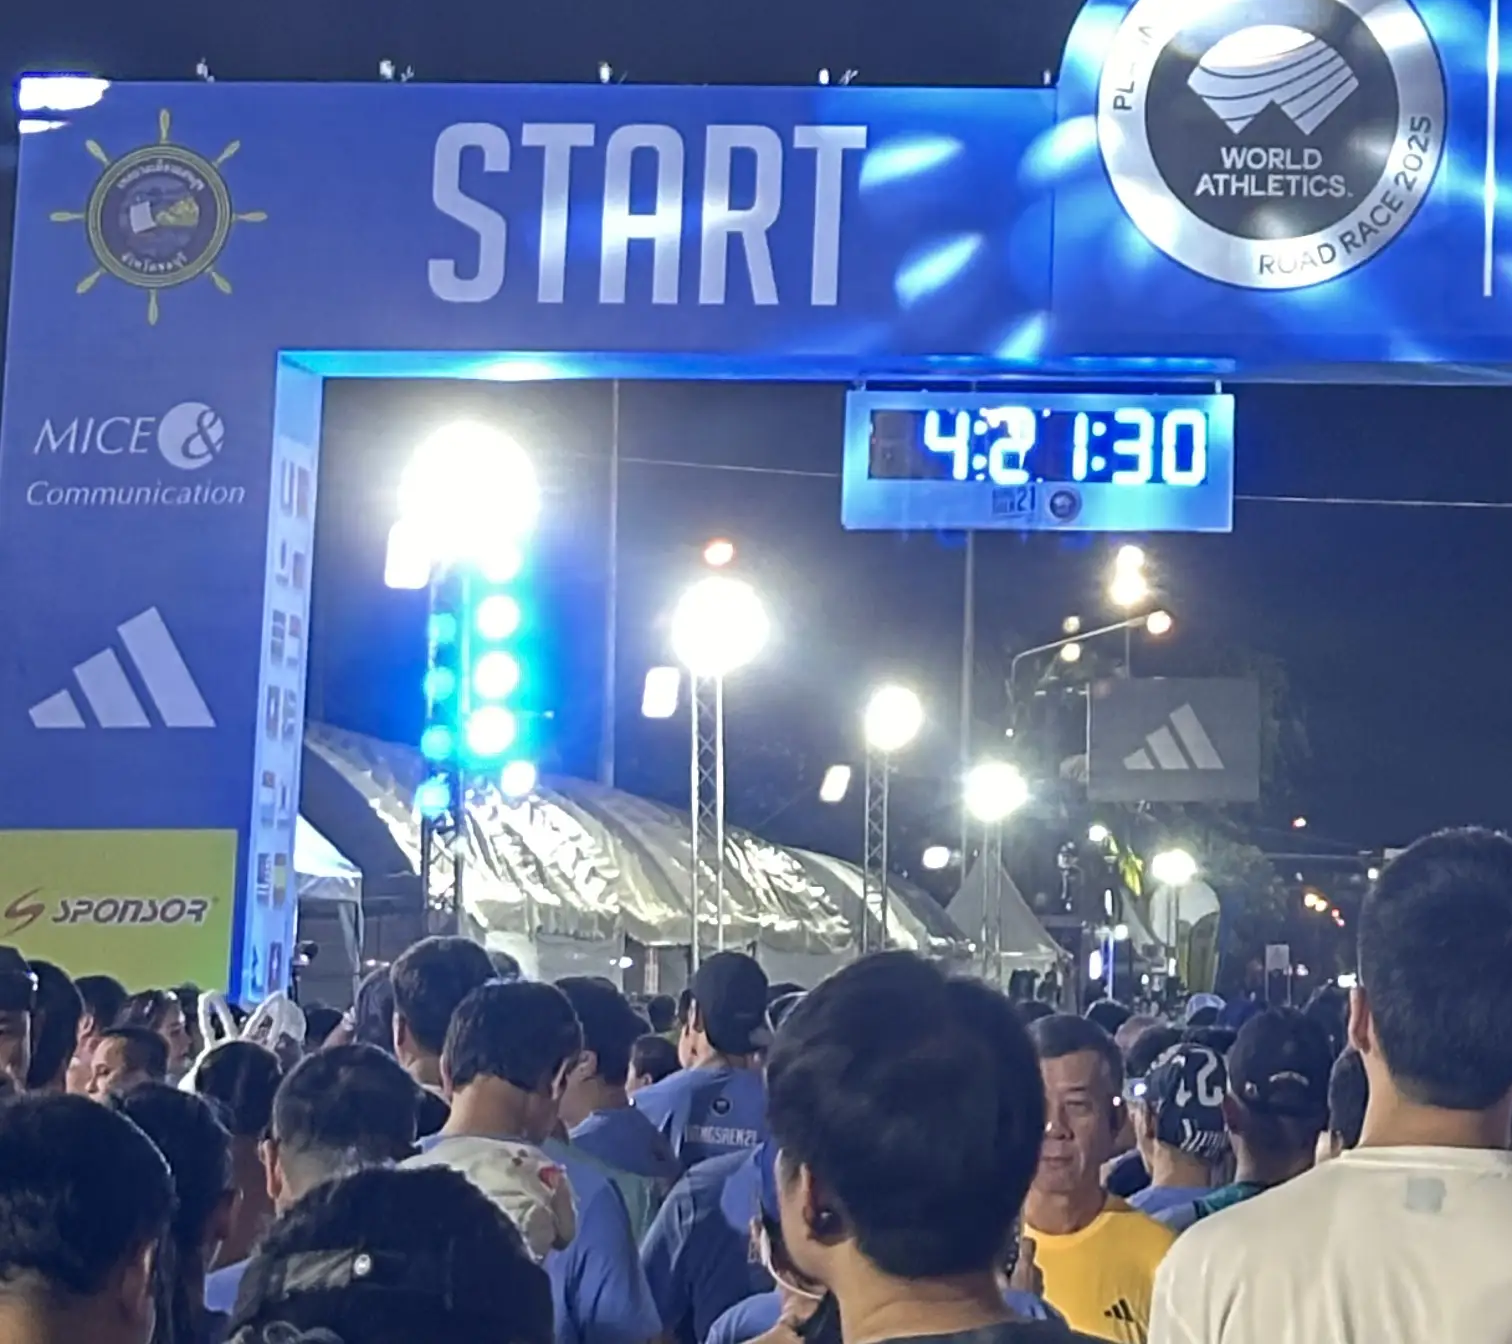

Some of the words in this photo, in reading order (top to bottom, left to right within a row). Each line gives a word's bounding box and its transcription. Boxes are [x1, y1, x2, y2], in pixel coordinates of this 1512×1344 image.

[1220, 147, 1323, 171] WORLD
[1341, 189, 1405, 255] RACE
[1393, 115, 1432, 193] 2025
[427, 120, 868, 307] START
[33, 415, 156, 455] MICE
[26, 478, 247, 507] Communication
[51, 897, 209, 925] SPONSOR
